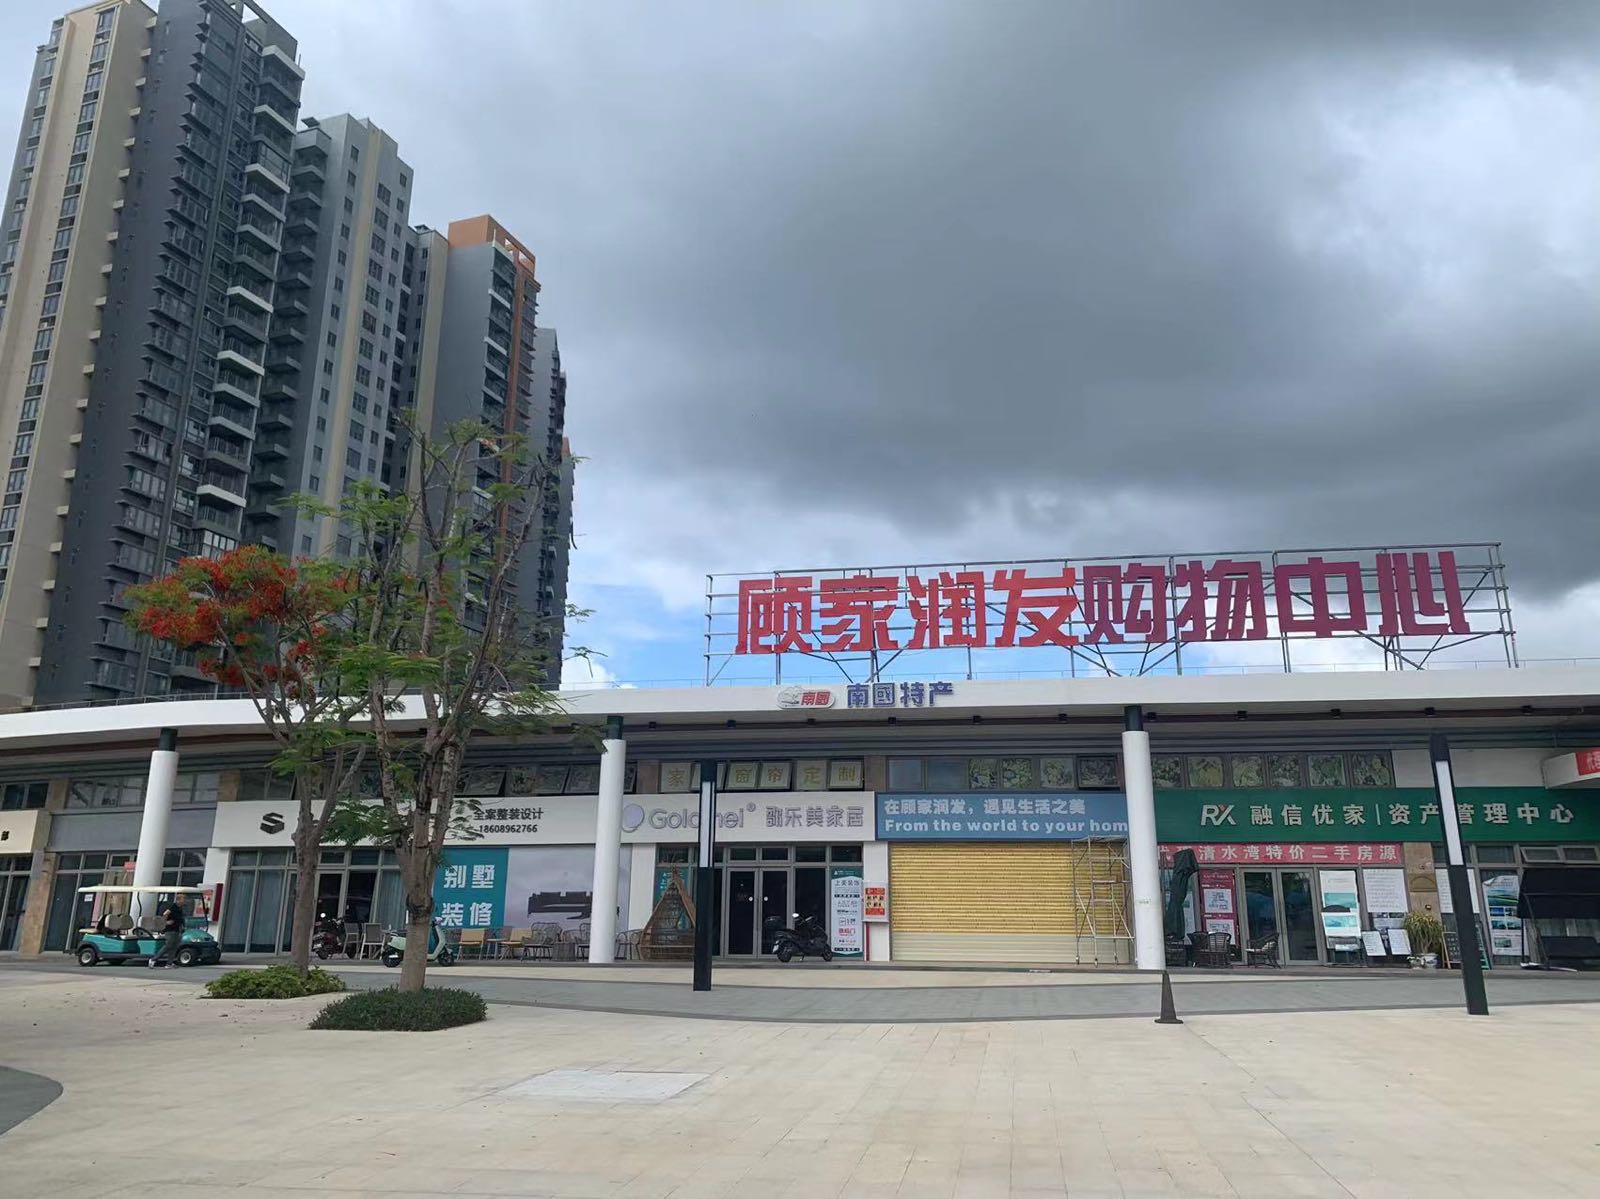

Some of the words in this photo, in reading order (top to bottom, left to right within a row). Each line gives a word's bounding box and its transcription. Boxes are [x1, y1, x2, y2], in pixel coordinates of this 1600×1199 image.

[735, 551, 1471, 655] 顾家润发购物中心
[480, 824, 538, 834] 18608962766
[885, 820, 929, 832] From
[932, 819, 962, 832] the
[967, 819, 1018, 832] world
[1022, 821, 1040, 832] to
[1044, 822, 1085, 834] your
[1090, 819, 1128, 832] hom
[443, 864, 495, 889] 别墅
[440, 901, 492, 927] 装修
